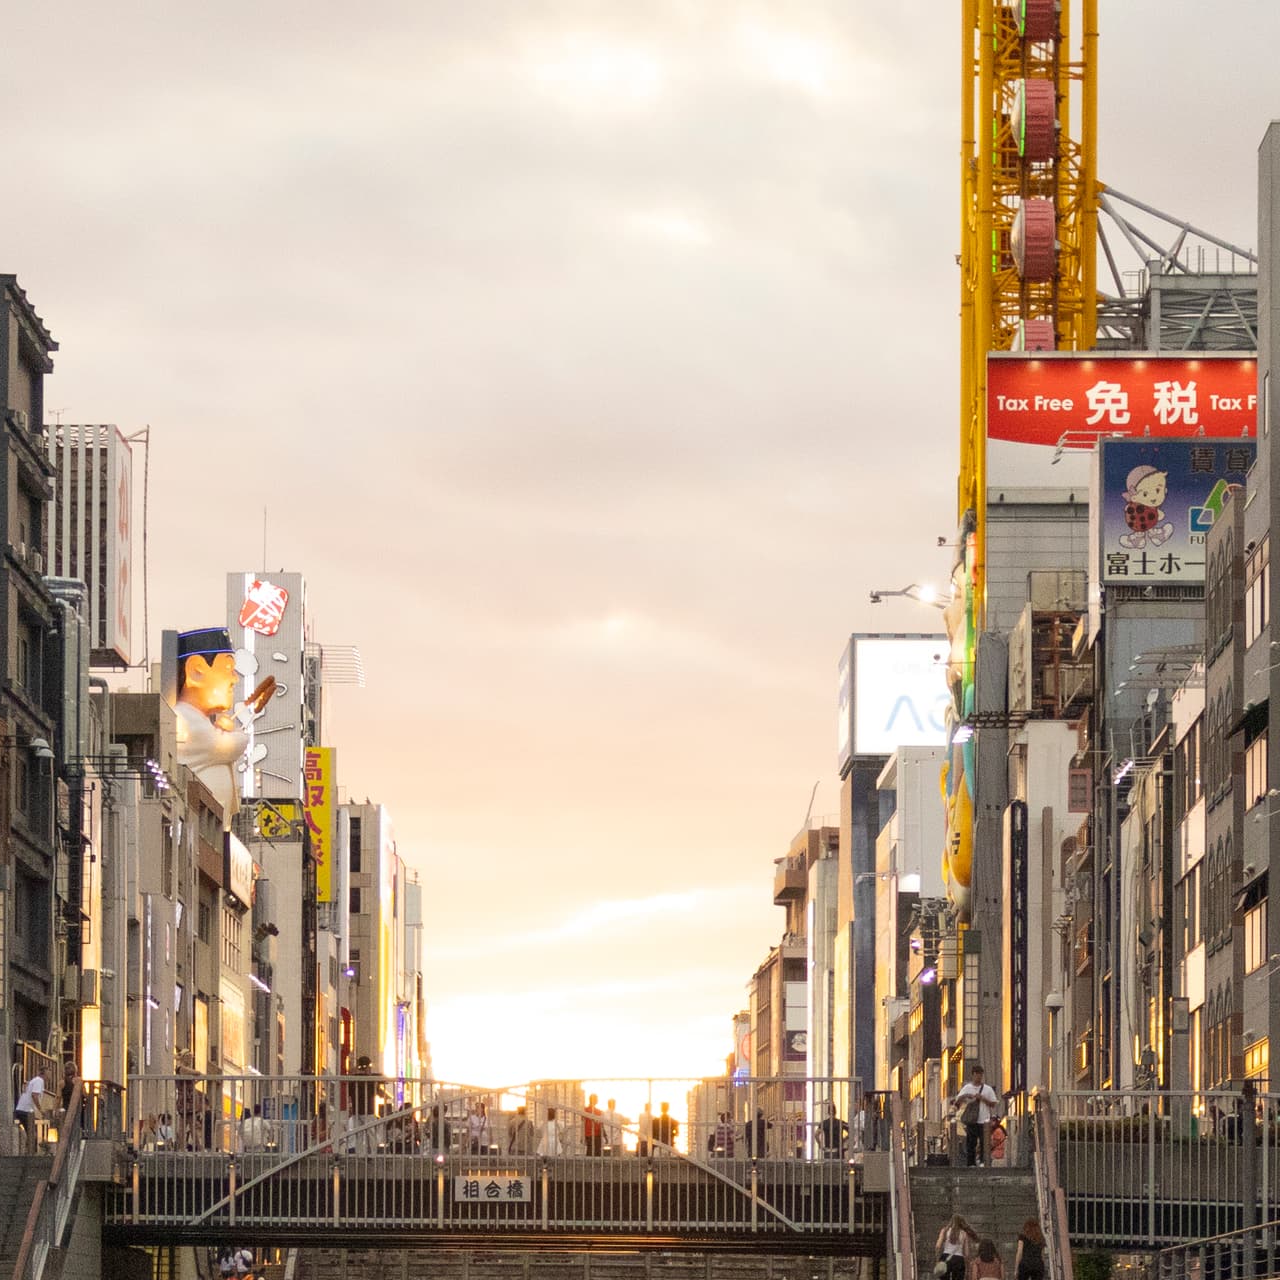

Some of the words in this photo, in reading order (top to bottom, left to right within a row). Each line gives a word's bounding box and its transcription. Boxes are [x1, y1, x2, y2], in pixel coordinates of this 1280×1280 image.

[997, 395, 1029, 412] Tax
[1034, 395, 1074, 412] Free
[1085, 380, 1199, 425] 免税
[1209, 394, 1243, 411] Tax
[1189, 447, 1252, 475] 賃貸
[1106, 551, 1206, 577] 富士ホー
[462, 1179, 524, 1199] 相合橋
